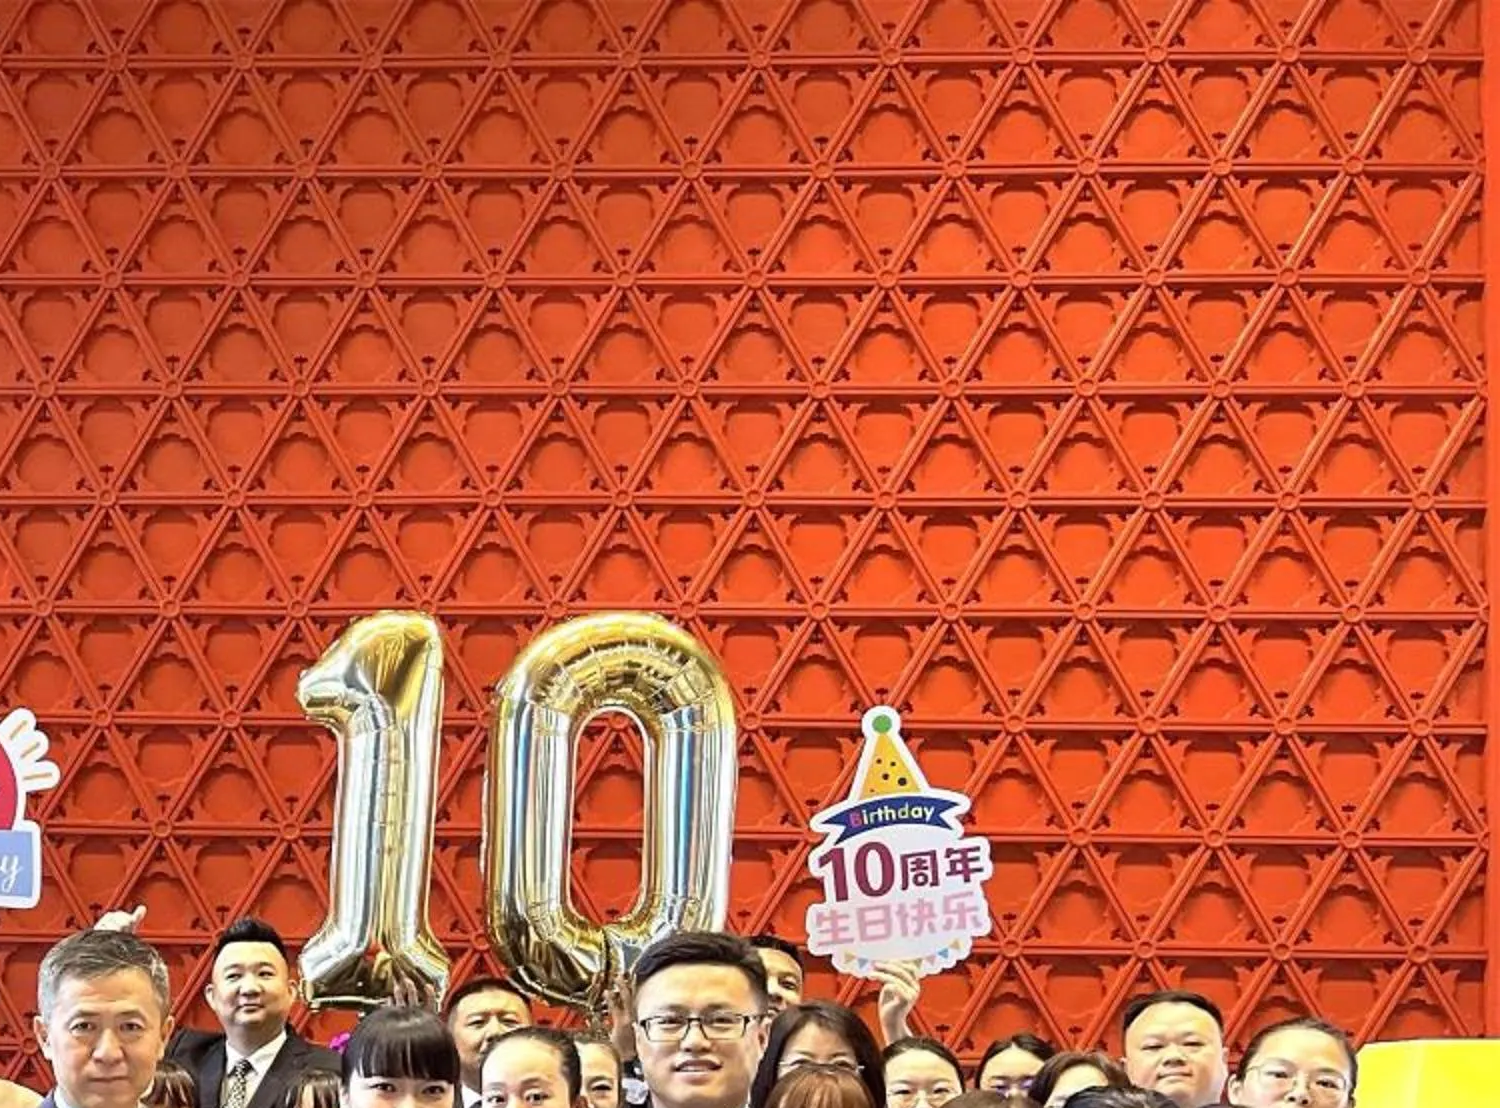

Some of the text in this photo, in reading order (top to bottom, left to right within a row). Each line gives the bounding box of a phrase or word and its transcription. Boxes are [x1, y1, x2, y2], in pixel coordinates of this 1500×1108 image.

[298, 609, 740, 1012] 10
[815, 891, 983, 948] 生日快乐
